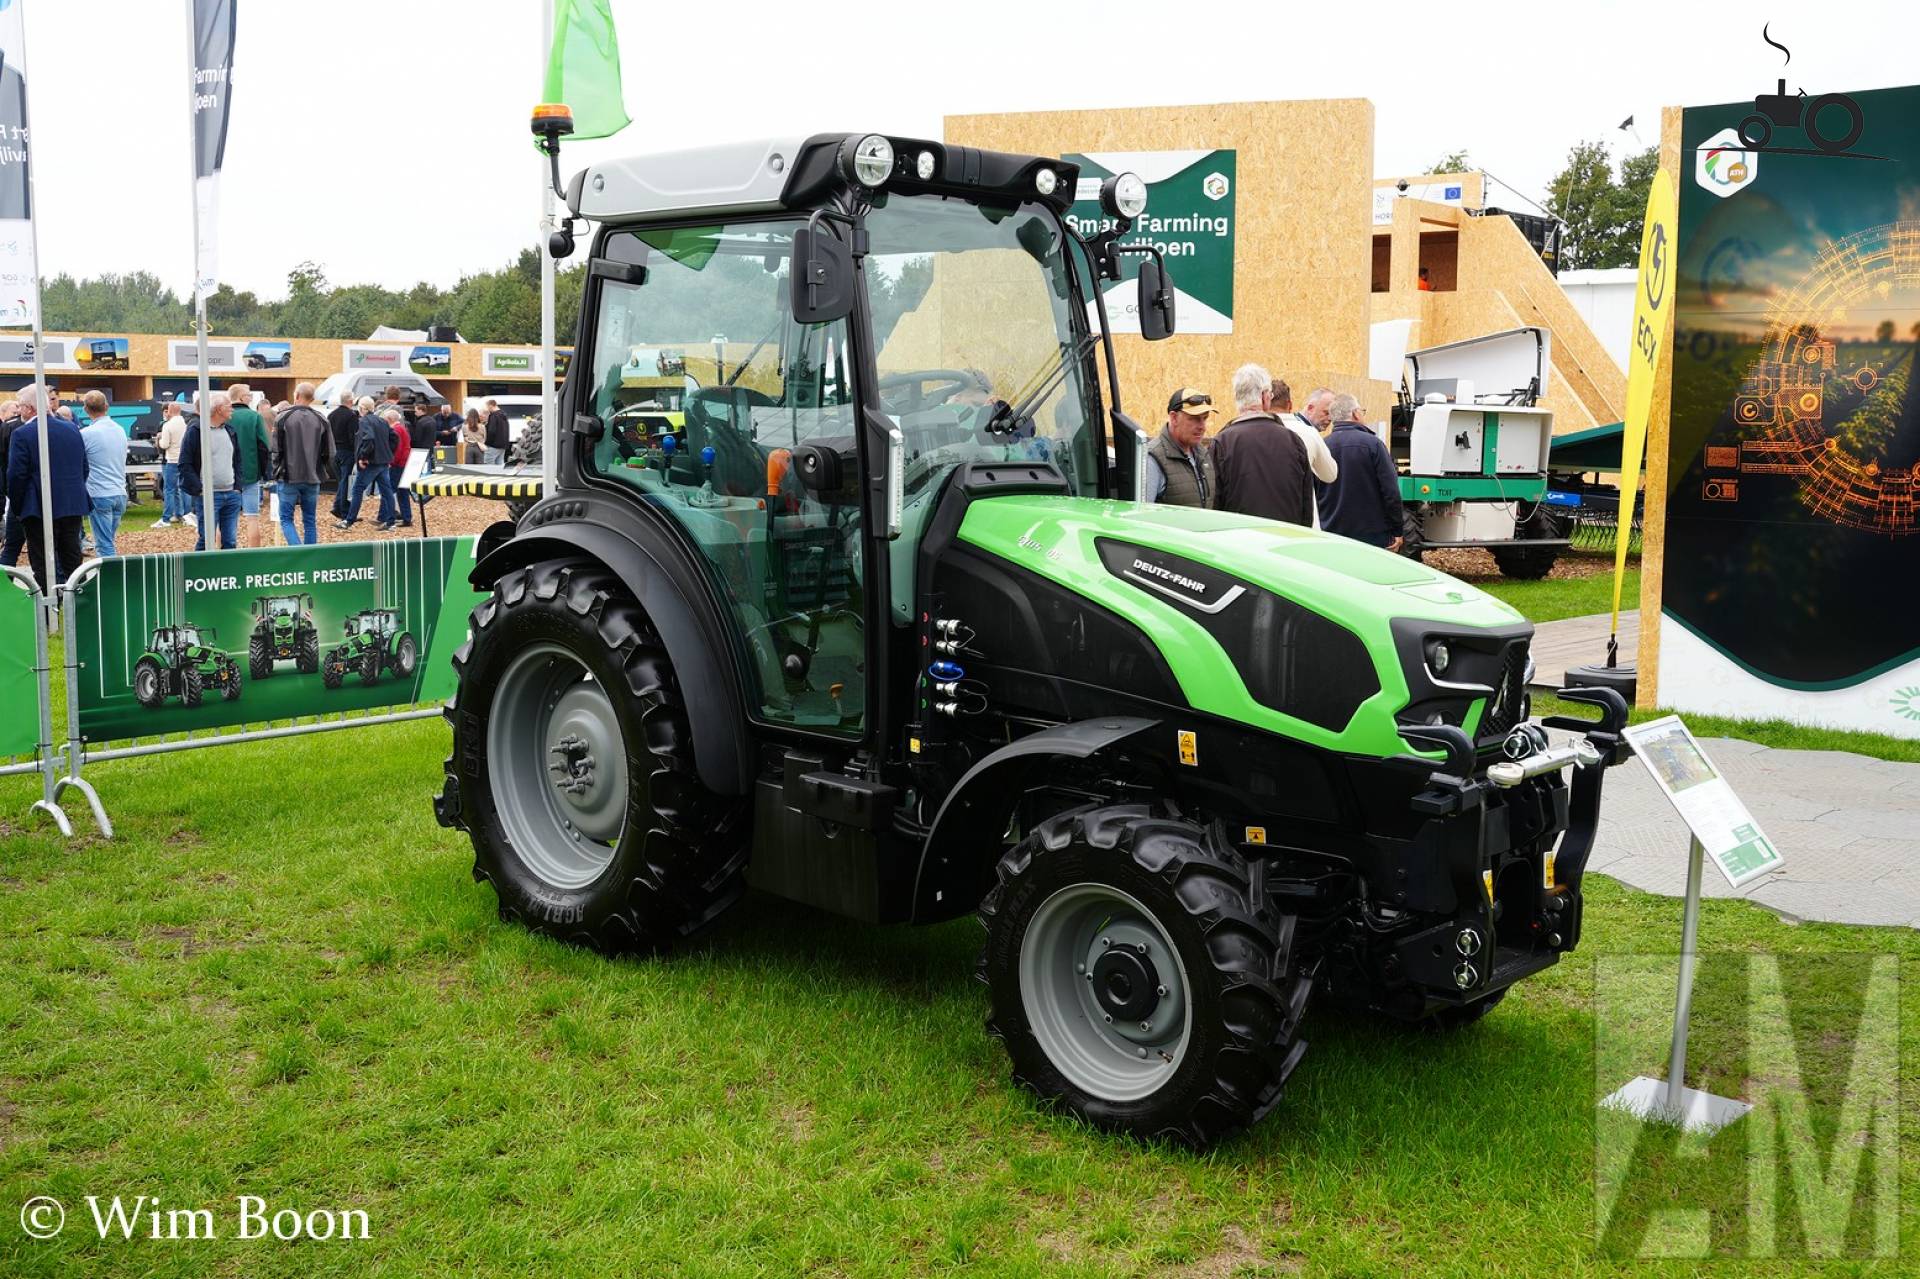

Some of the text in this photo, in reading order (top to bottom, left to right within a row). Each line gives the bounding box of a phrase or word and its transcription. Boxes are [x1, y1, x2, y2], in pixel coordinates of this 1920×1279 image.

[1065, 212, 1228, 236] Smar Farming
[1637, 314, 1657, 371] ECX
[185, 566, 379, 592] POWER. PRECISIE. PRESTATIE.
[1133, 559, 1206, 593] DEUTZ-FAHR
